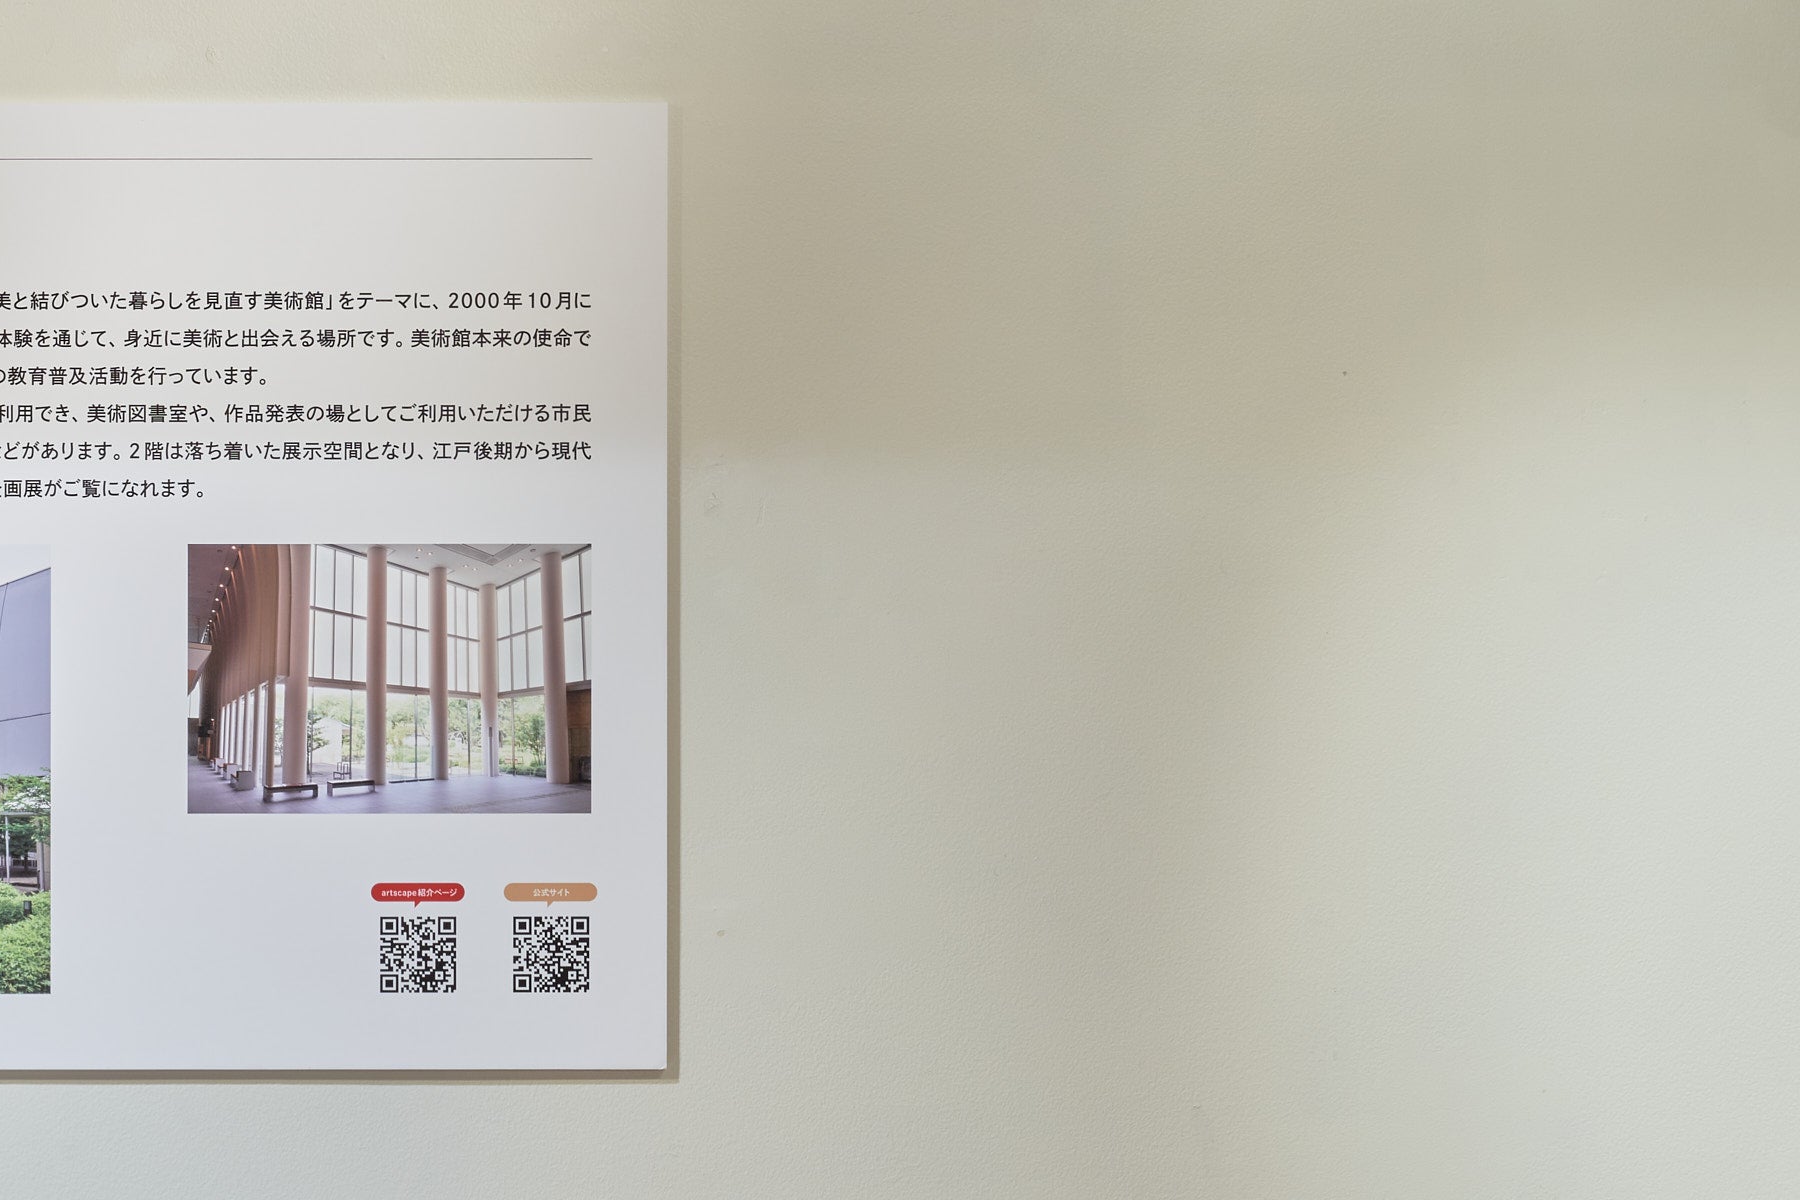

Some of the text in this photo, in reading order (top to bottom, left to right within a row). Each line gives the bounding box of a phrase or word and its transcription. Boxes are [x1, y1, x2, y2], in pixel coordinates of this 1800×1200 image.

[382, 888, 457, 898] artscape紹介ページ
[533, 888, 570, 897] 公式サイト
